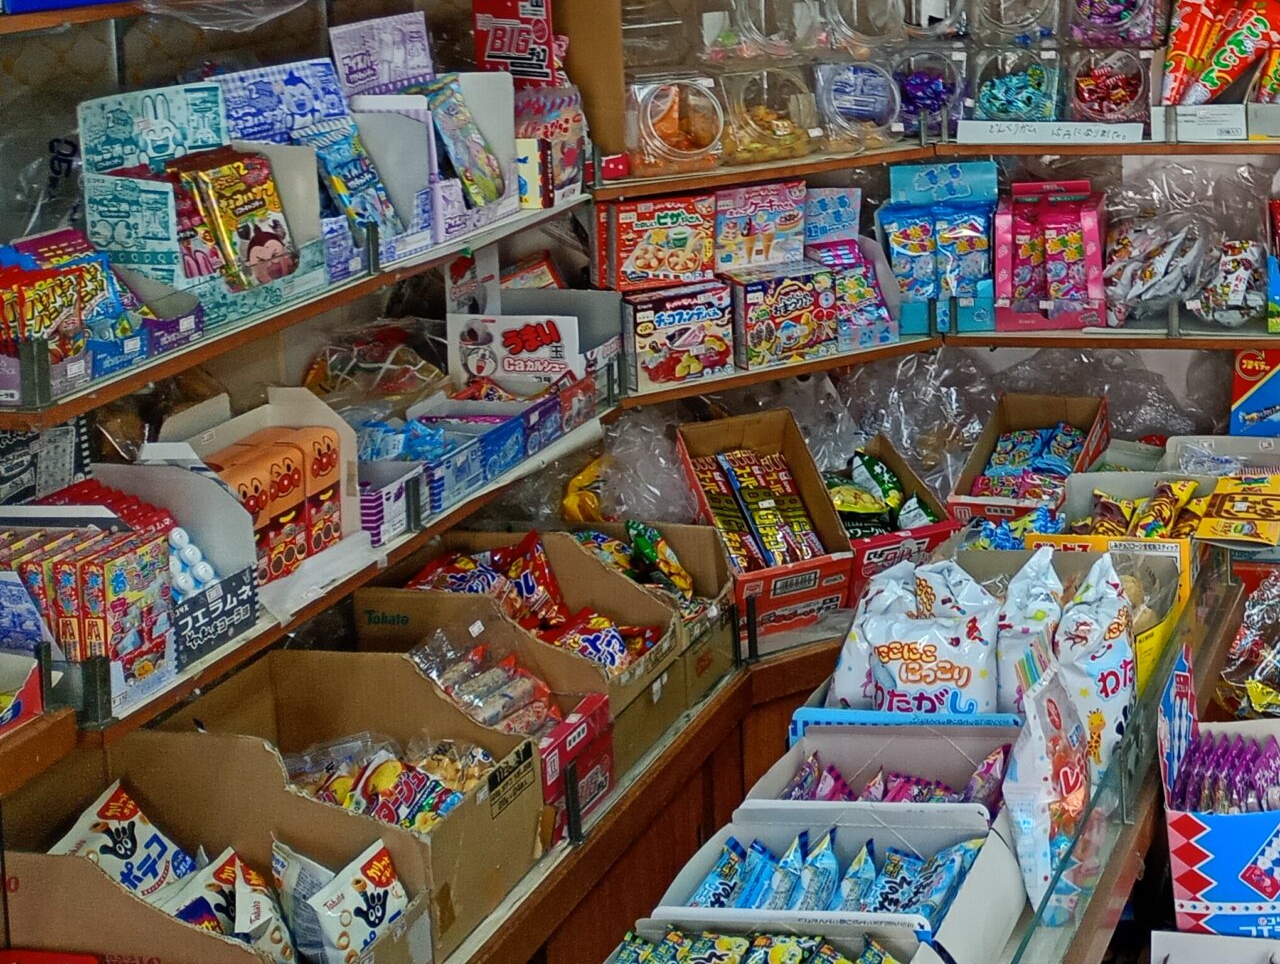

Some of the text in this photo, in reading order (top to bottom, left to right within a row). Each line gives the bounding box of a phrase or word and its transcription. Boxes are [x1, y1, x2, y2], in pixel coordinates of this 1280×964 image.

[487, 24, 532, 56] BIG
[504, 320, 562, 355] うまい
[551, 345, 563, 359] 玉
[178, 585, 254, 634] フエラムネ
[874, 642, 938, 664] にこにこ
[899, 661, 973, 688] にっこり
[120, 833, 169, 893] ポテコ
